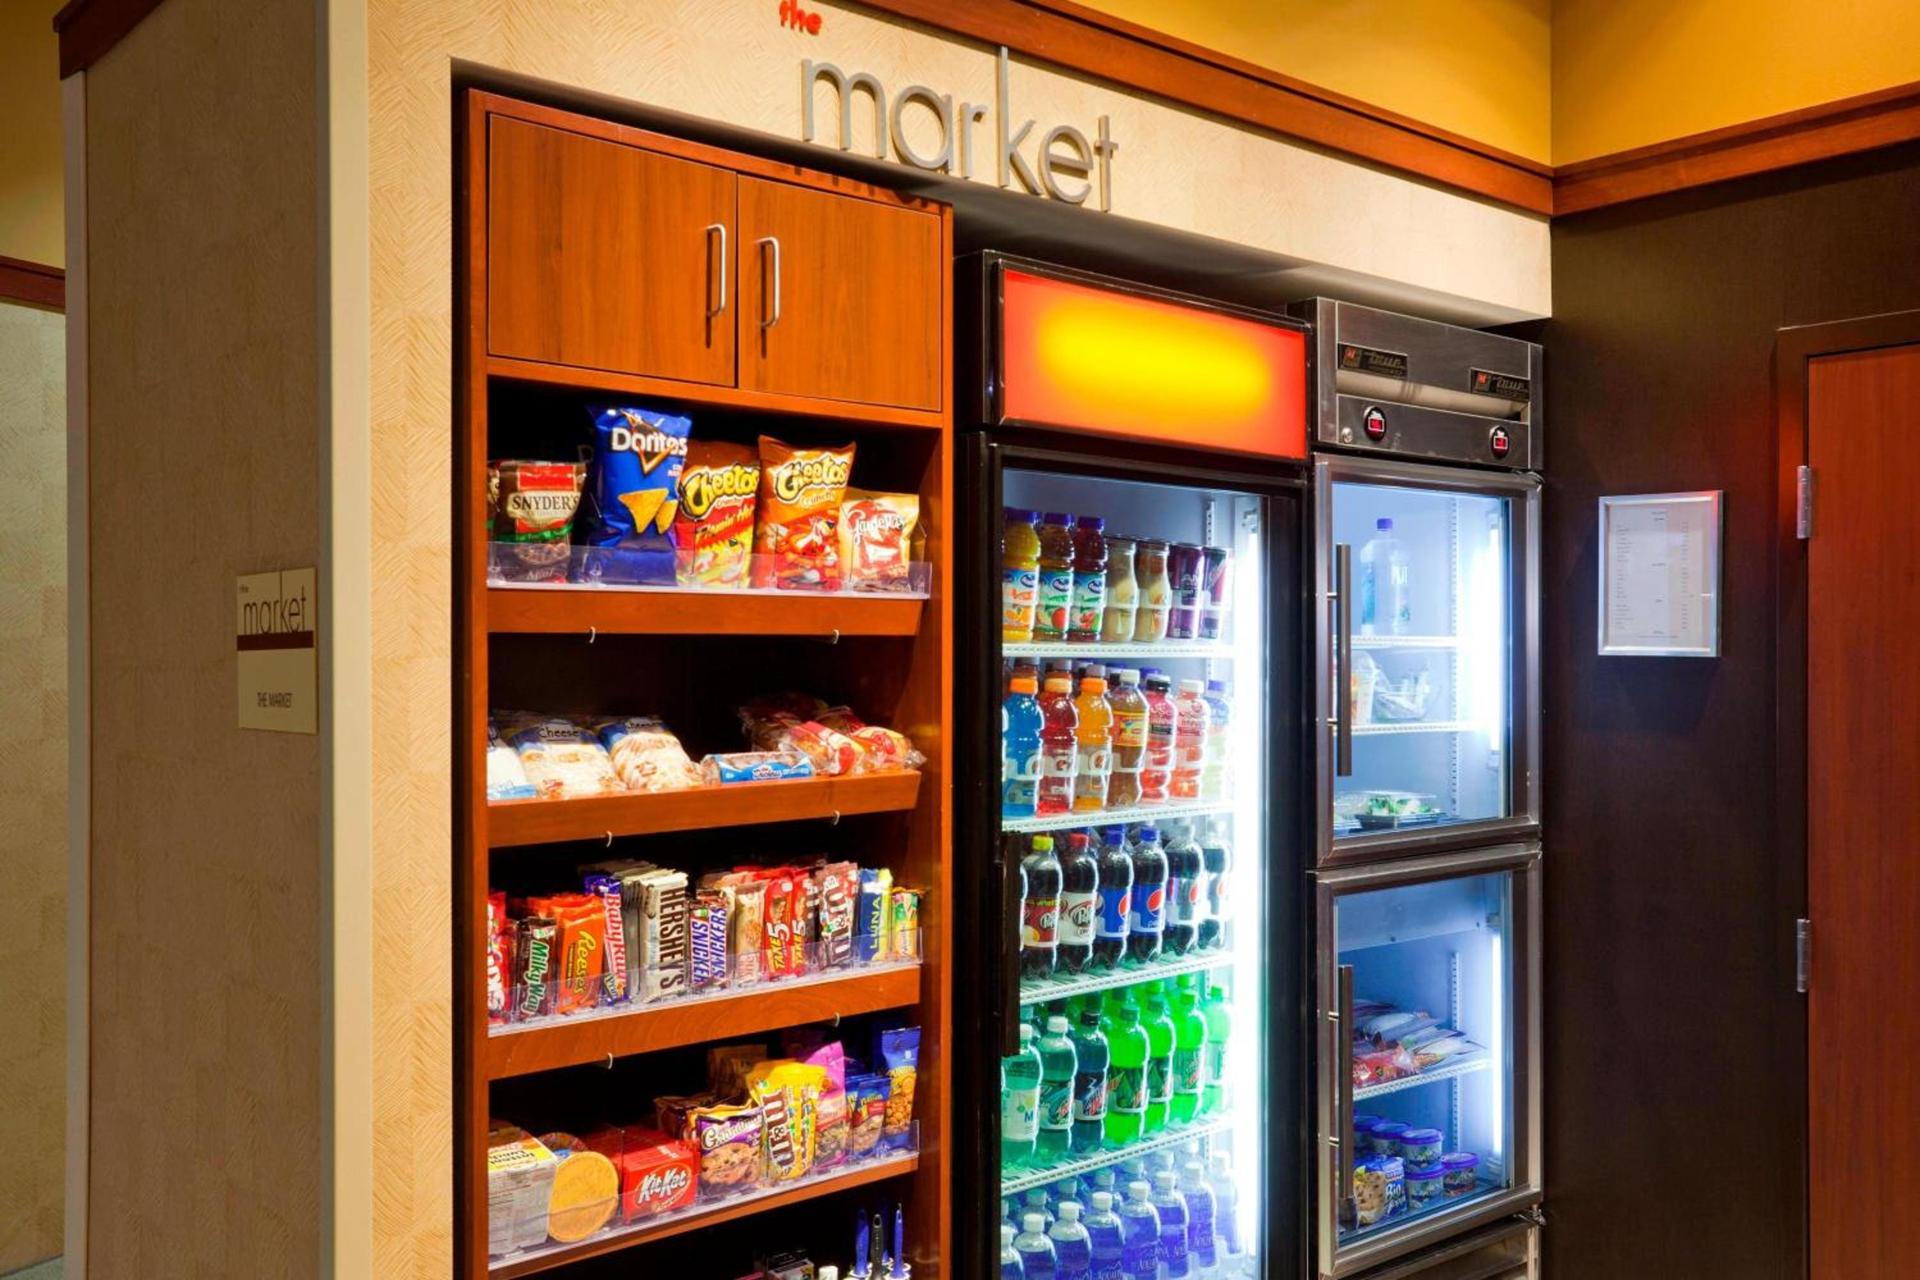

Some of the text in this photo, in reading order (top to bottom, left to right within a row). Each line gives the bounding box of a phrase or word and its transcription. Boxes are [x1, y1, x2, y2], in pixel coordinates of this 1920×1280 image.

[779, 0, 822, 35] the
[801, 46, 1119, 213] market
[611, 427, 688, 456] Doritos
[512, 494, 579, 511] SNYDER'S
[680, 464, 756, 518] Cheetos
[773, 455, 848, 502] Cheetos
[244, 570, 306, 634] market
[539, 724, 579, 738] Cheese
[659, 889, 685, 990] HERSHEY'S
[710, 907, 727, 978] SNICKERS
[766, 922, 790, 970] TAKE 5
[869, 897, 882, 949] LUNA
[520, 940, 550, 1015] Milky Way
